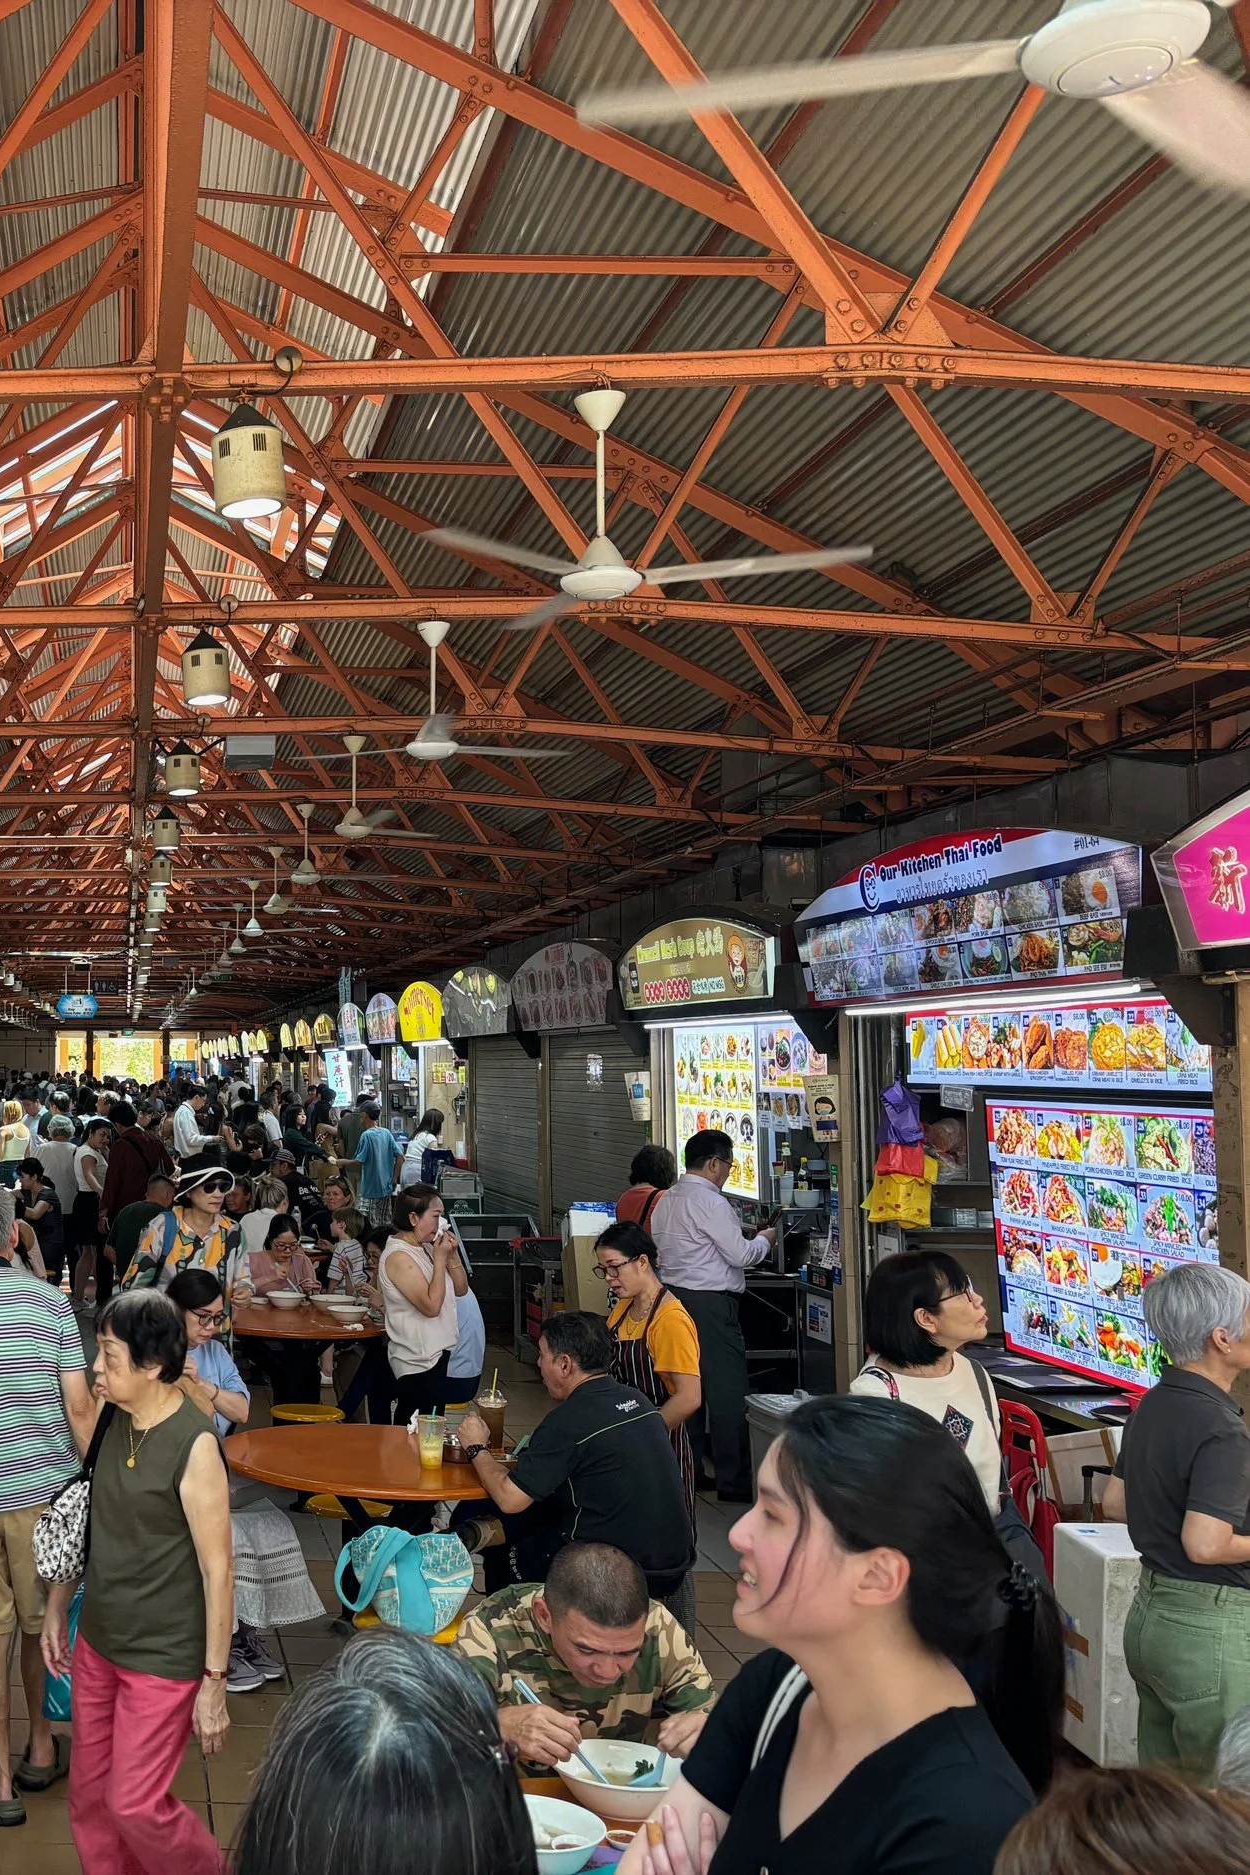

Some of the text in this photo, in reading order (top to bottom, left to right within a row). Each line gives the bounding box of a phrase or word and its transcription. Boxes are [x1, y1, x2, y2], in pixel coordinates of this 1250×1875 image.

[880, 834, 1002, 882] Our Kitchen Thai Food
[331, 1050, 344, 1088] 甘蔗汁
[1126, 1170, 1135, 1178] RICE
[1051, 1226, 1078, 1236] MANGO SALAD
[1151, 1247, 1169, 1255] CHICKEN
